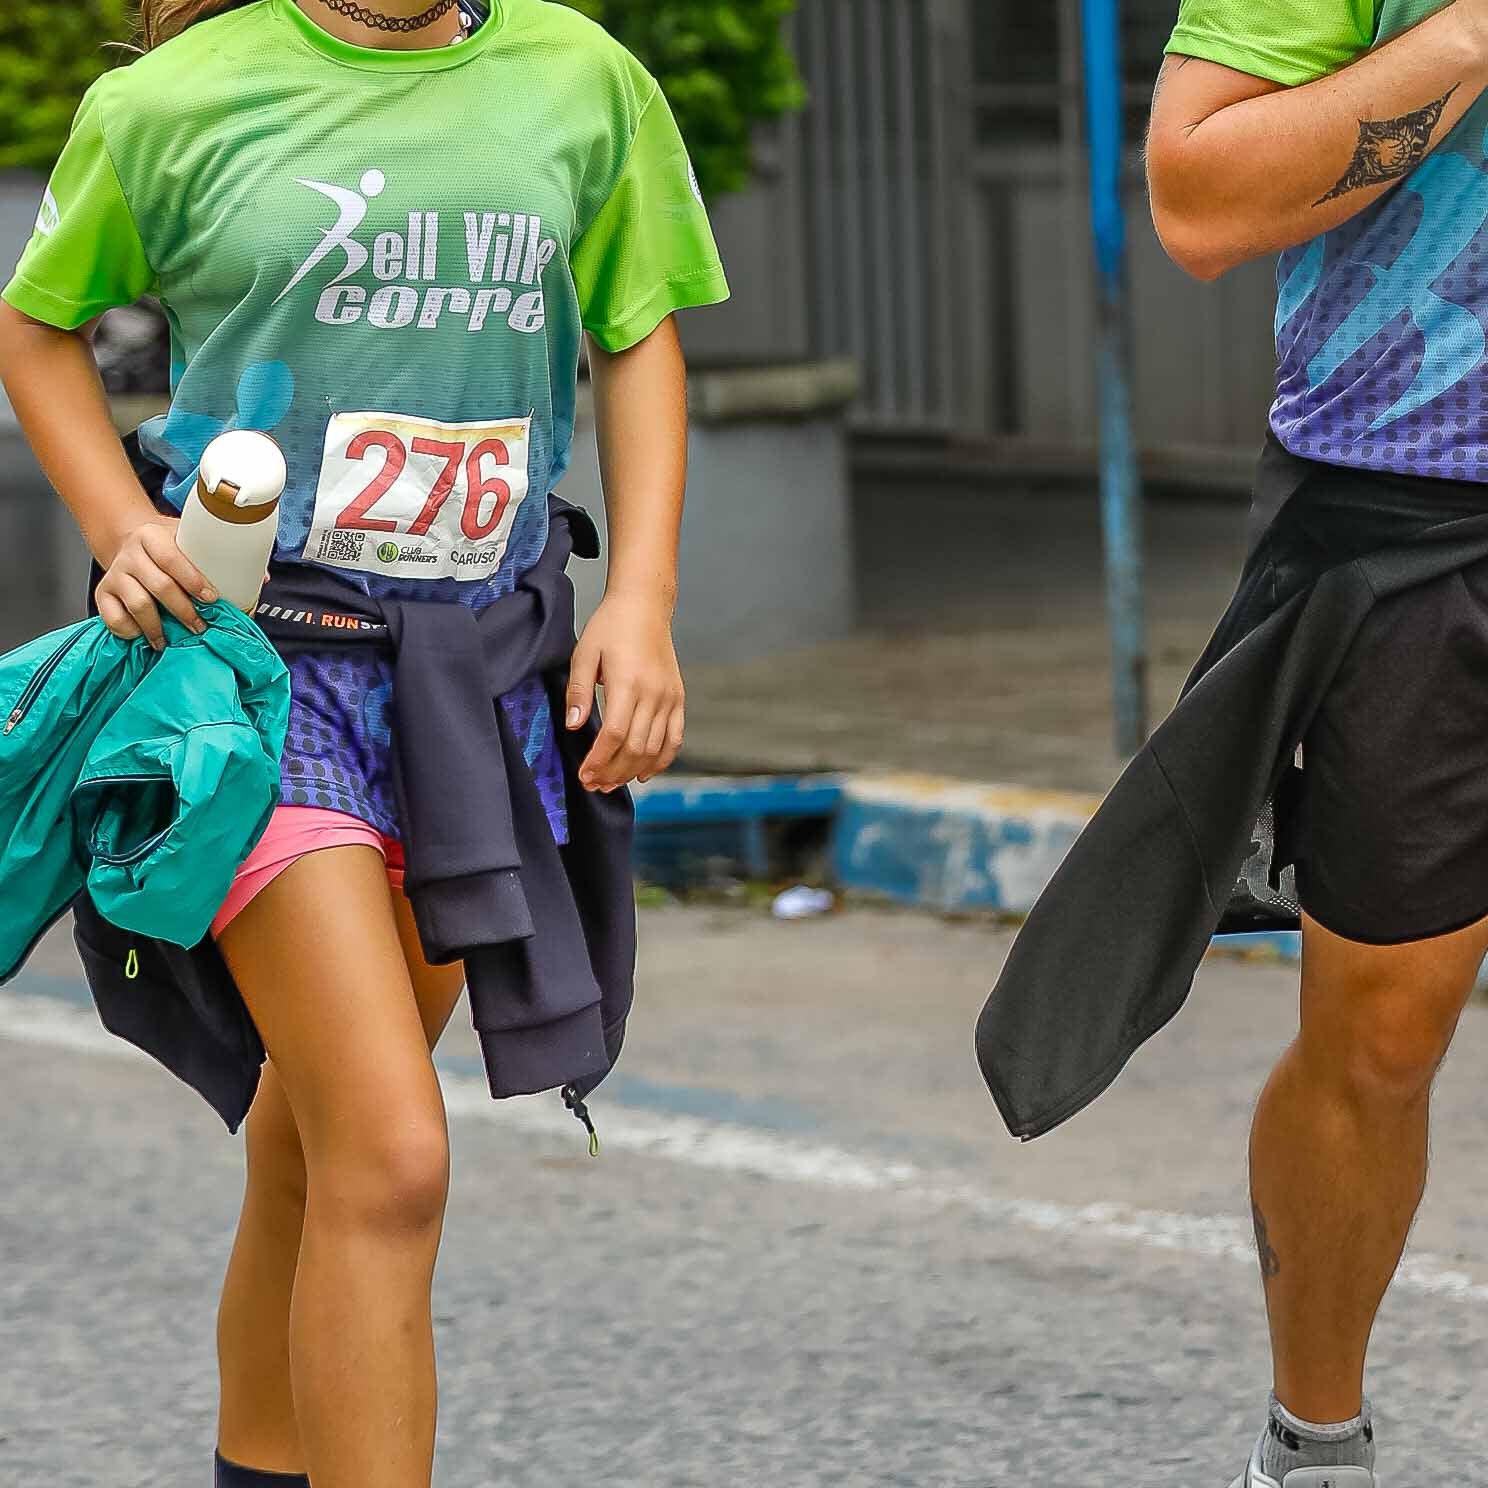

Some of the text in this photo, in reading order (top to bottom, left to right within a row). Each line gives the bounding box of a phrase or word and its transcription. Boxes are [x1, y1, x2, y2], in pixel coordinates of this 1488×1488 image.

[334, 430, 511, 540] 276
[400, 546, 423, 555] CLUB
[450, 550, 497, 566] CARUSO
